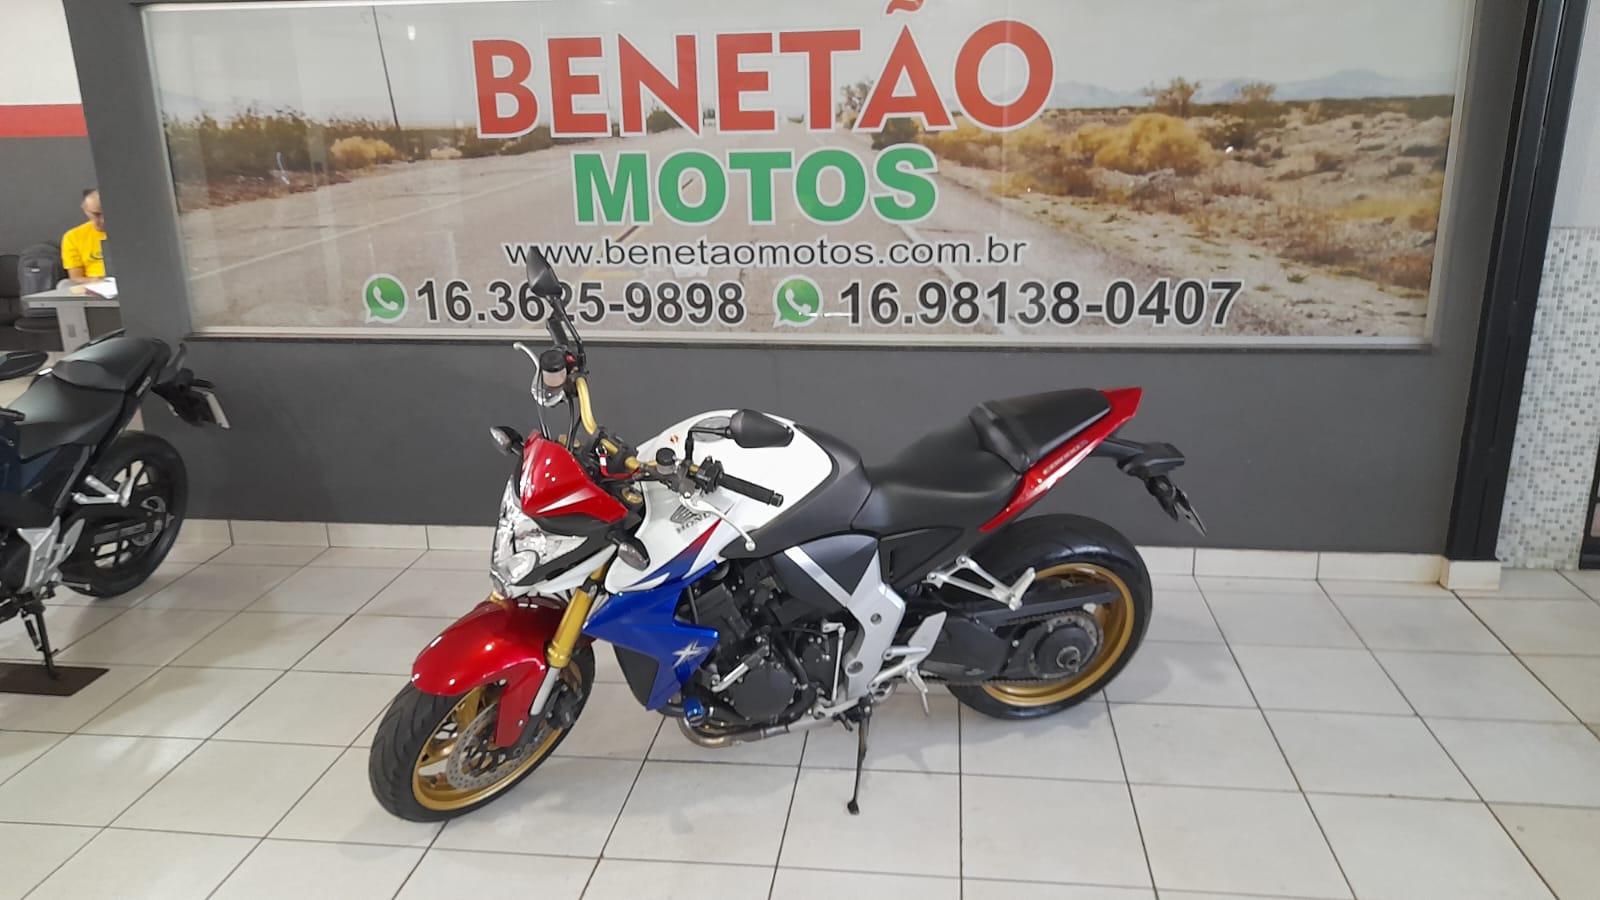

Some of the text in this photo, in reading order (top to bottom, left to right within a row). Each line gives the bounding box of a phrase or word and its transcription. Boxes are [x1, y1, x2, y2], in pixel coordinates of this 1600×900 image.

[472, 0, 1054, 136] BENETÃO
[573, 148, 937, 224] MOTOS
[505, 236, 1027, 268] www.benetaomotos.com.br
[840, 279, 1243, 326] 16.98138-0407
[676, 511, 712, 534] HOND
